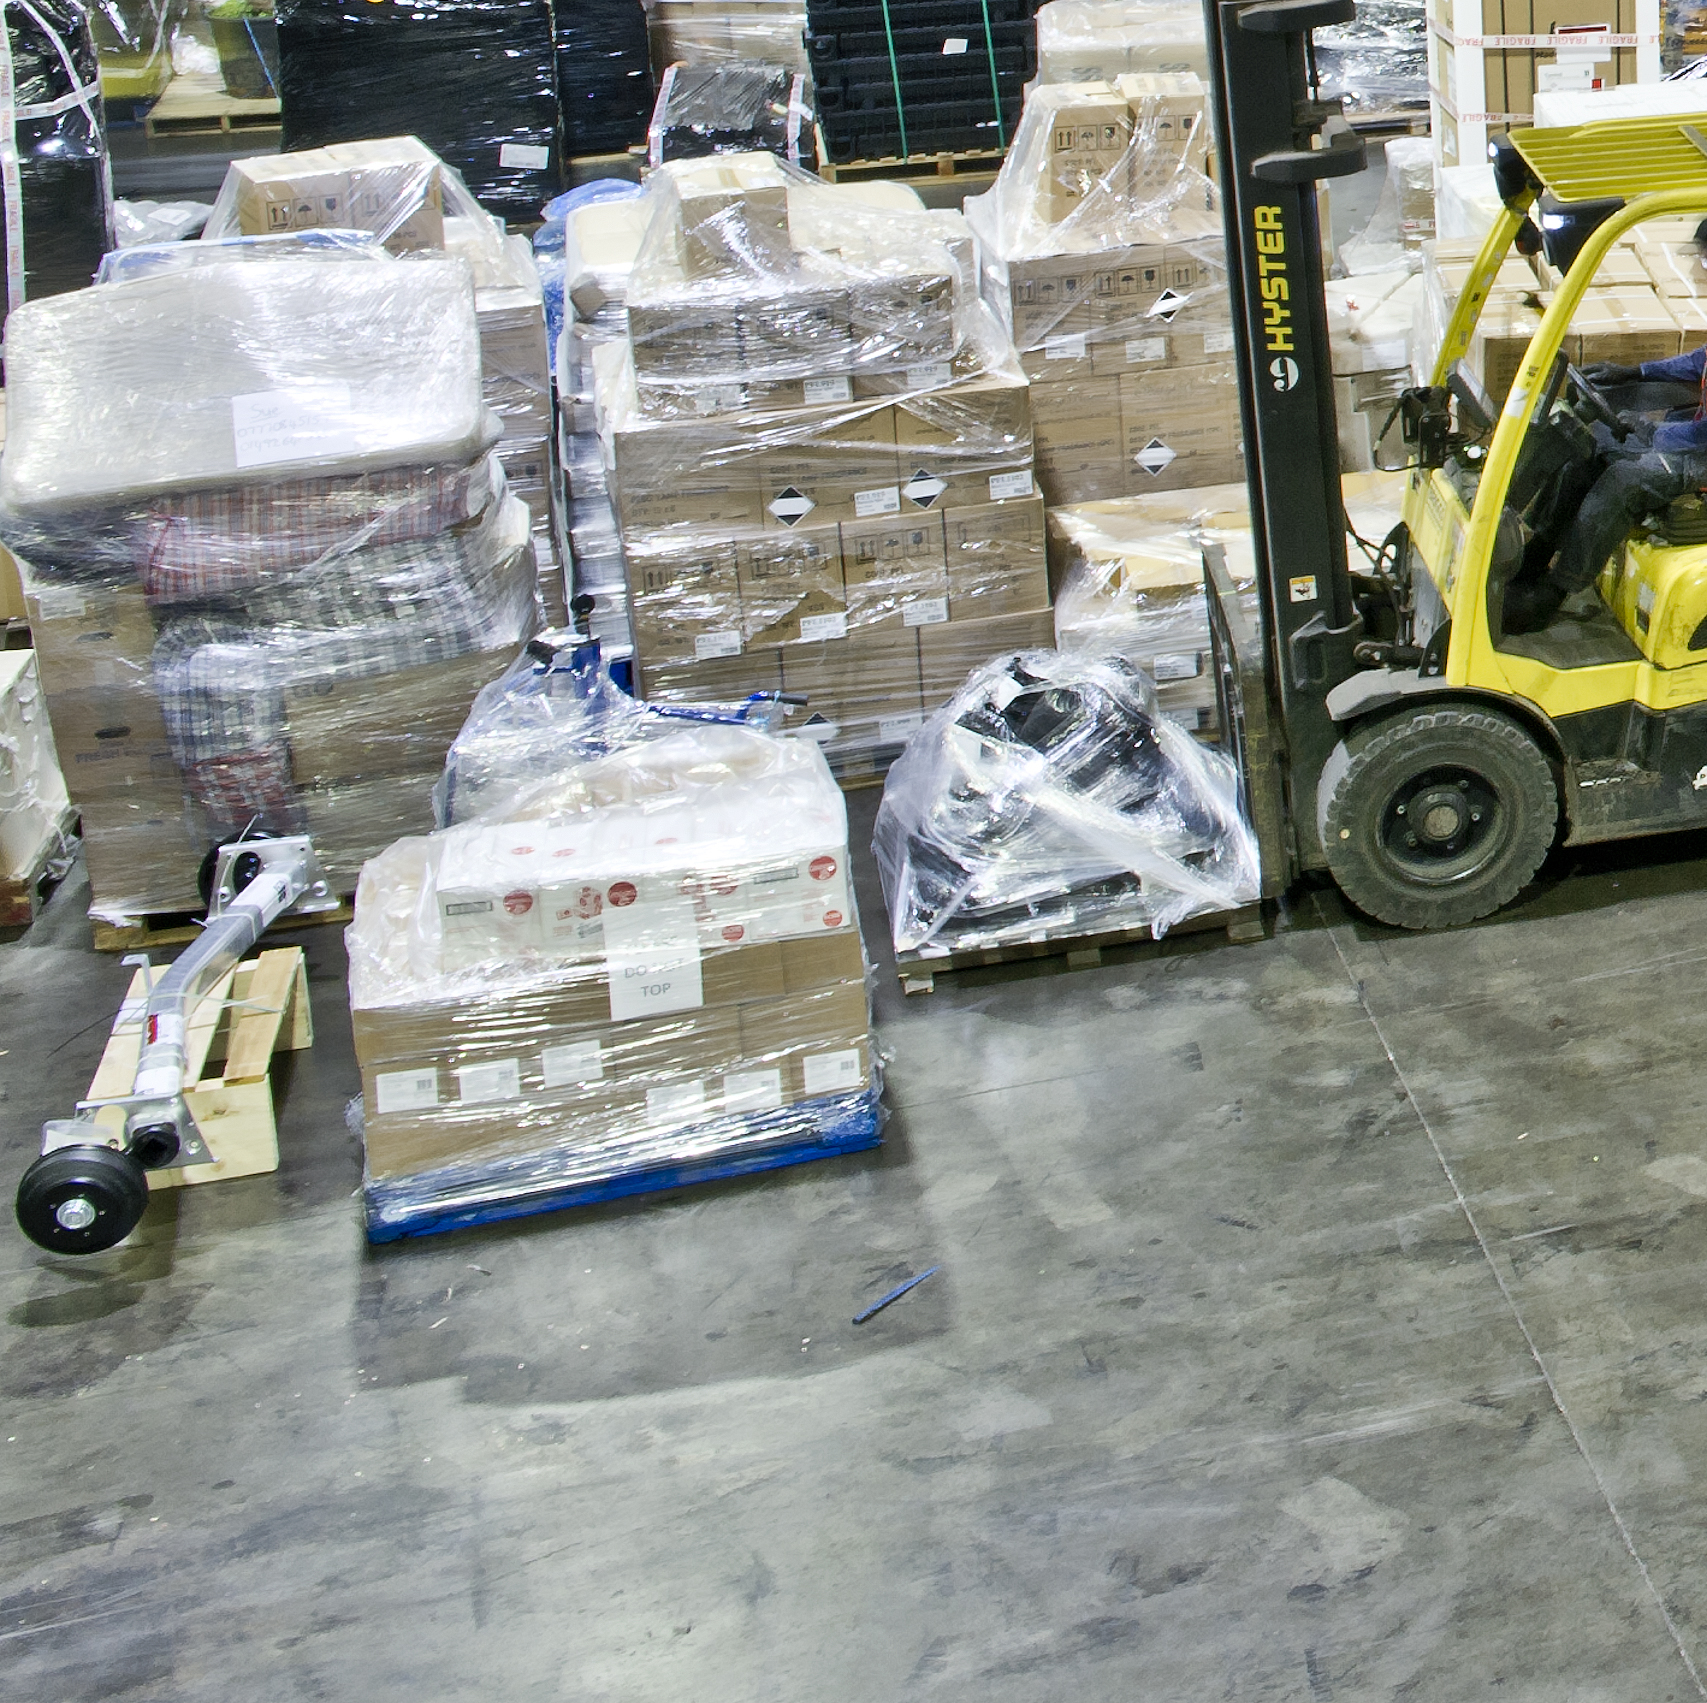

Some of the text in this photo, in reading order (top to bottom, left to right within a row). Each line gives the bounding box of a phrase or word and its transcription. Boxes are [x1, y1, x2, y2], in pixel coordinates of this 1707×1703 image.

[1494, 36, 1537, 46] FRAGILE
[1546, 35, 1587, 45] FRAGILE
[1599, 34, 1639, 44] FRAGILE
[1253, 204, 1295, 352] HYSTER
[624, 965, 647, 978] DO
[641, 982, 671, 998] TOP
